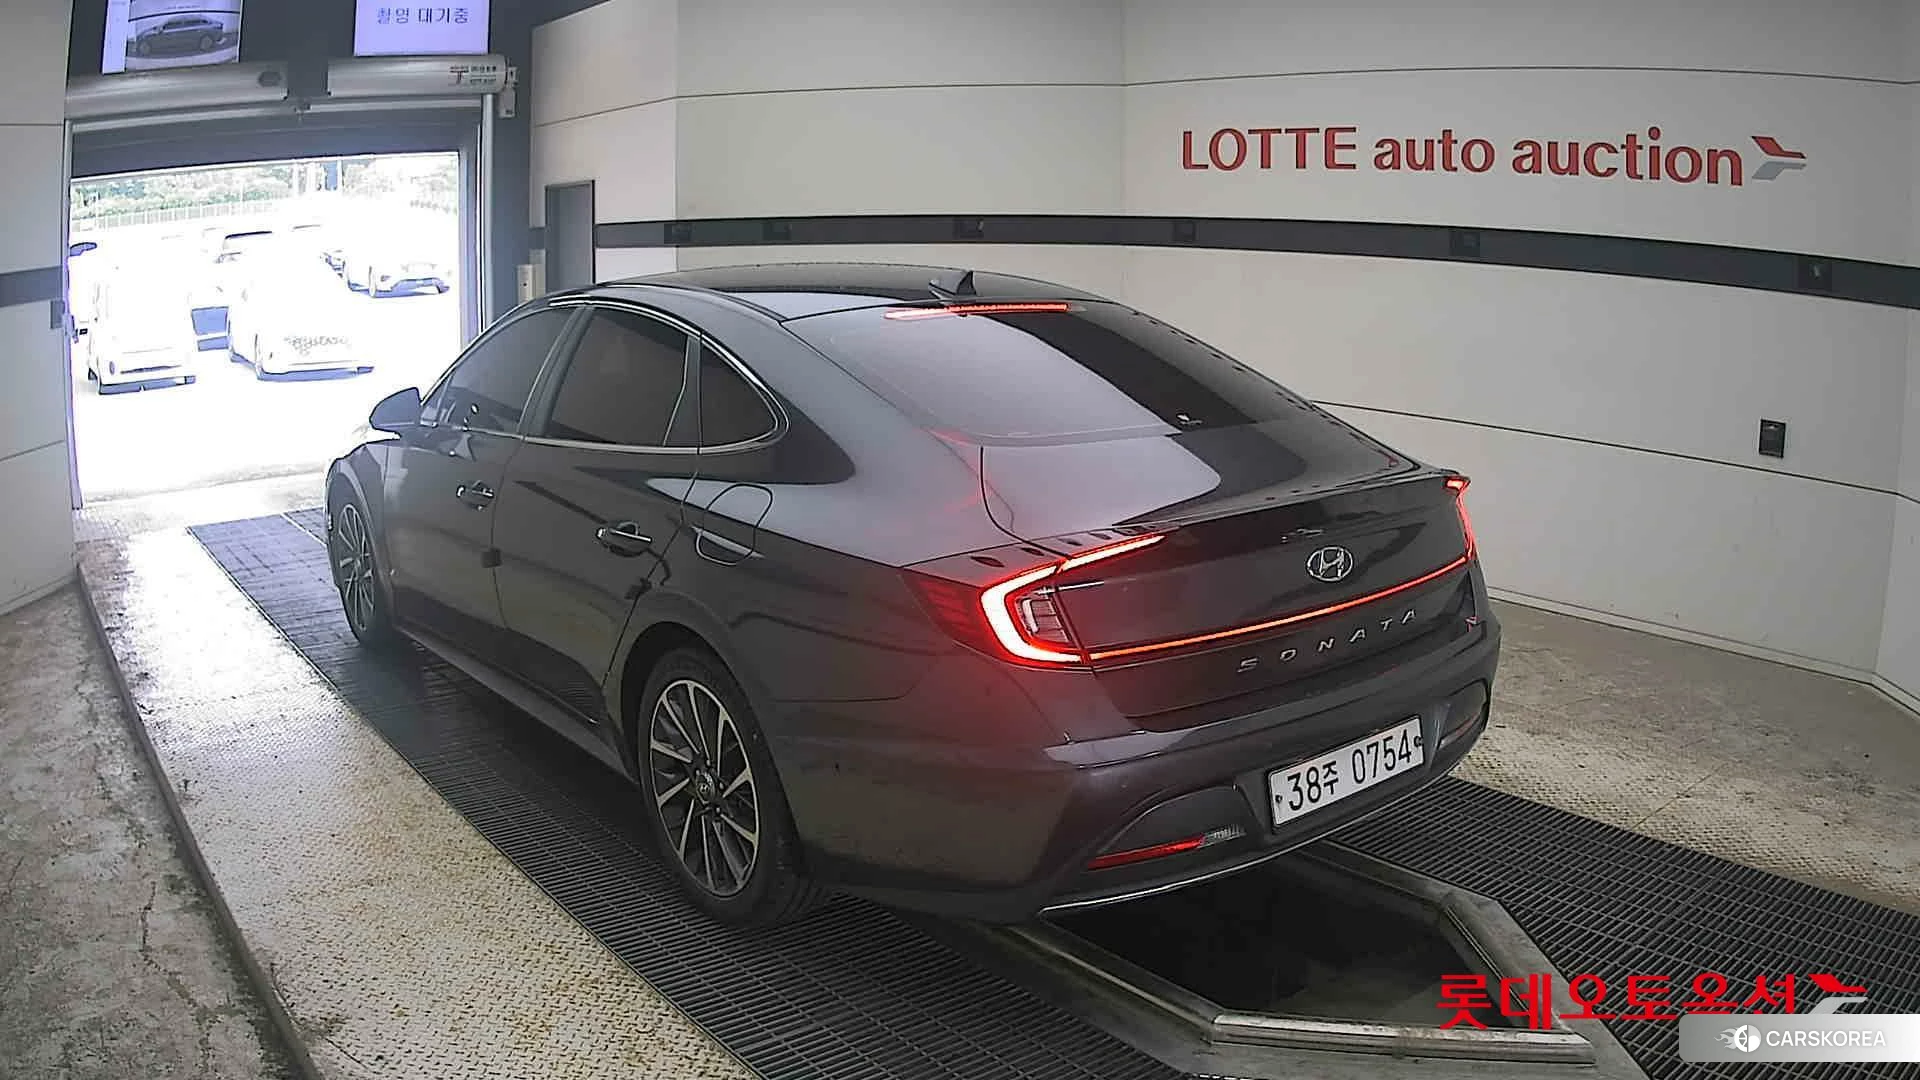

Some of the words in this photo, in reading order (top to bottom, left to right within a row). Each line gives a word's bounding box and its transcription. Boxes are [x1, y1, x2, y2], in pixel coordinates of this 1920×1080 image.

[418, 7, 469, 24] 대기중
[1181, 126, 1358, 172] LOTTE
[1373, 129, 1496, 173] auto
[1511, 126, 1744, 187] auction
[1236, 608, 1418, 673] SONATA
[1286, 760, 1340, 812] 38주
[1351, 728, 1413, 785] 0754
